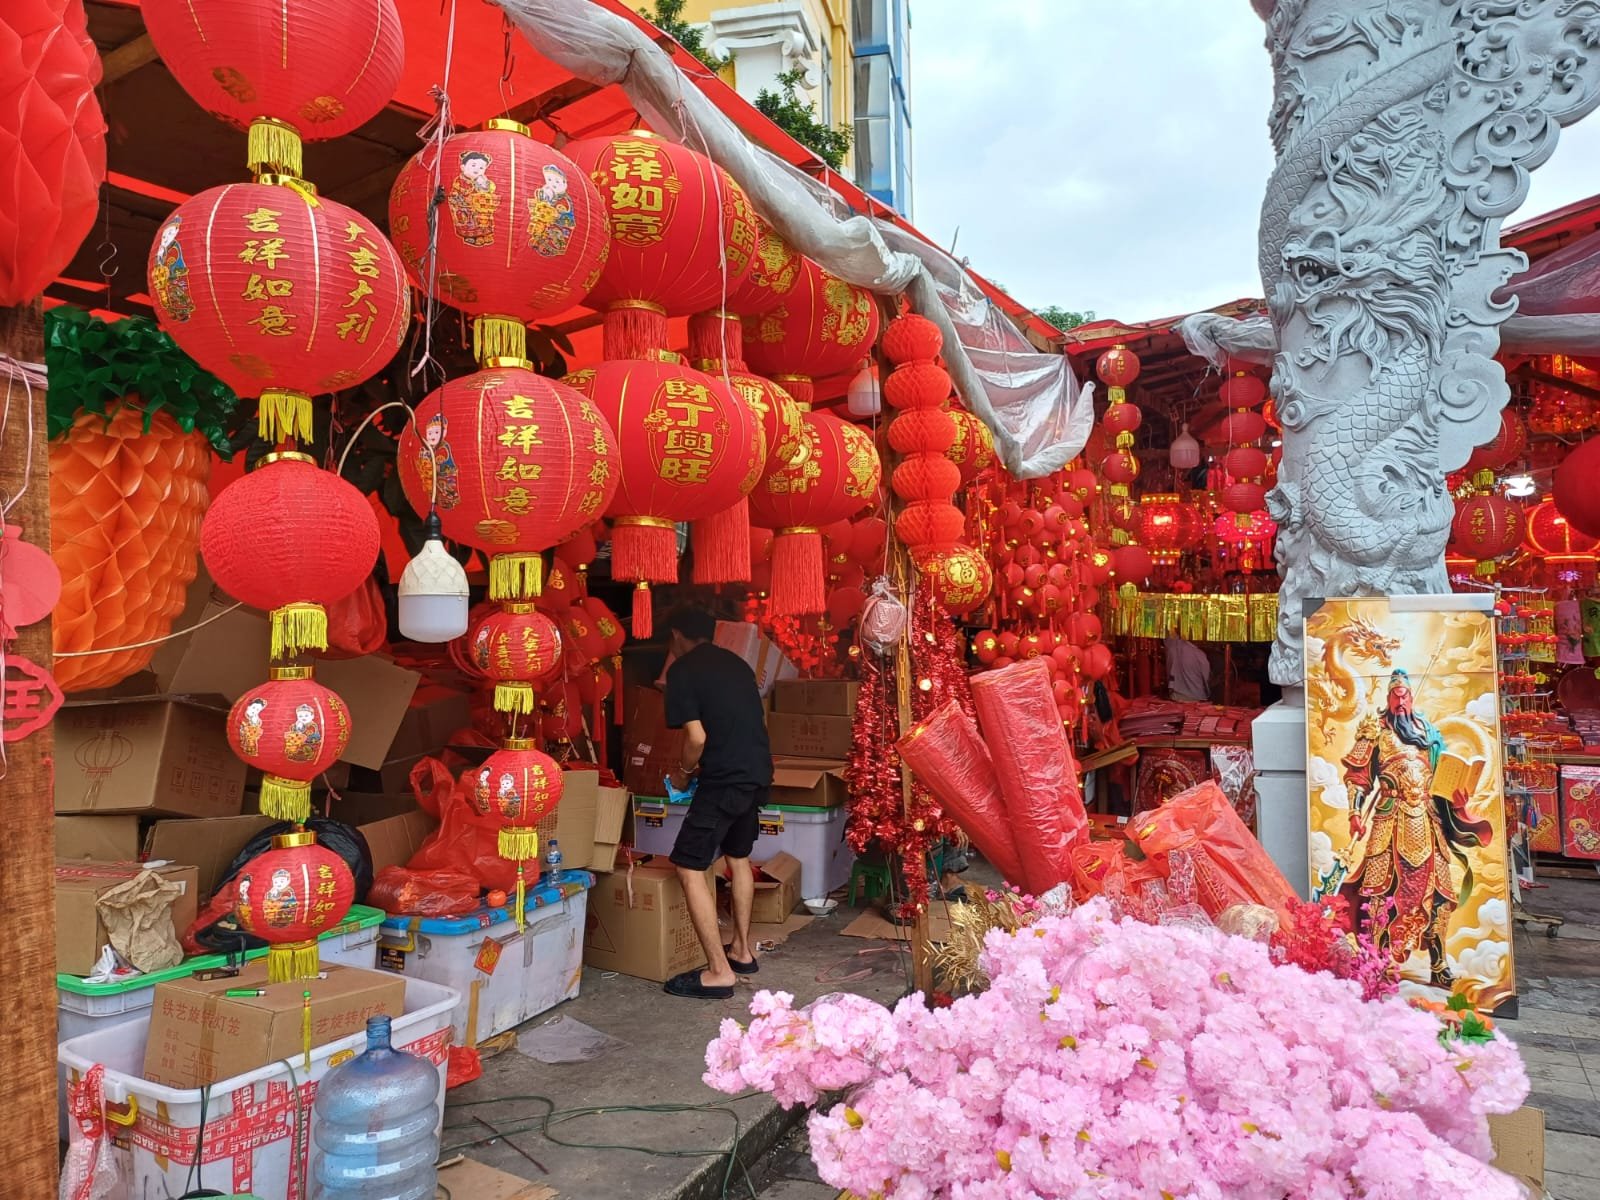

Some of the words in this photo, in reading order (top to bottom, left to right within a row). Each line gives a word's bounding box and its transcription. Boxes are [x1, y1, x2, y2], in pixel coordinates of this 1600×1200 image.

[609, 141, 664, 242] 吉祥如意
[238, 207, 297, 336] 吉祥如意
[335, 220, 381, 344] 大吉大利
[493, 394, 543, 515] 吉祥如意
[659, 380, 715, 484] 財丁興旺
[162, 999, 241, 1037] 铁艺旋转灯笼
[230, 1127, 288, 1154] FRAGILE
[300, 1103, 310, 1160] FRAGILE
